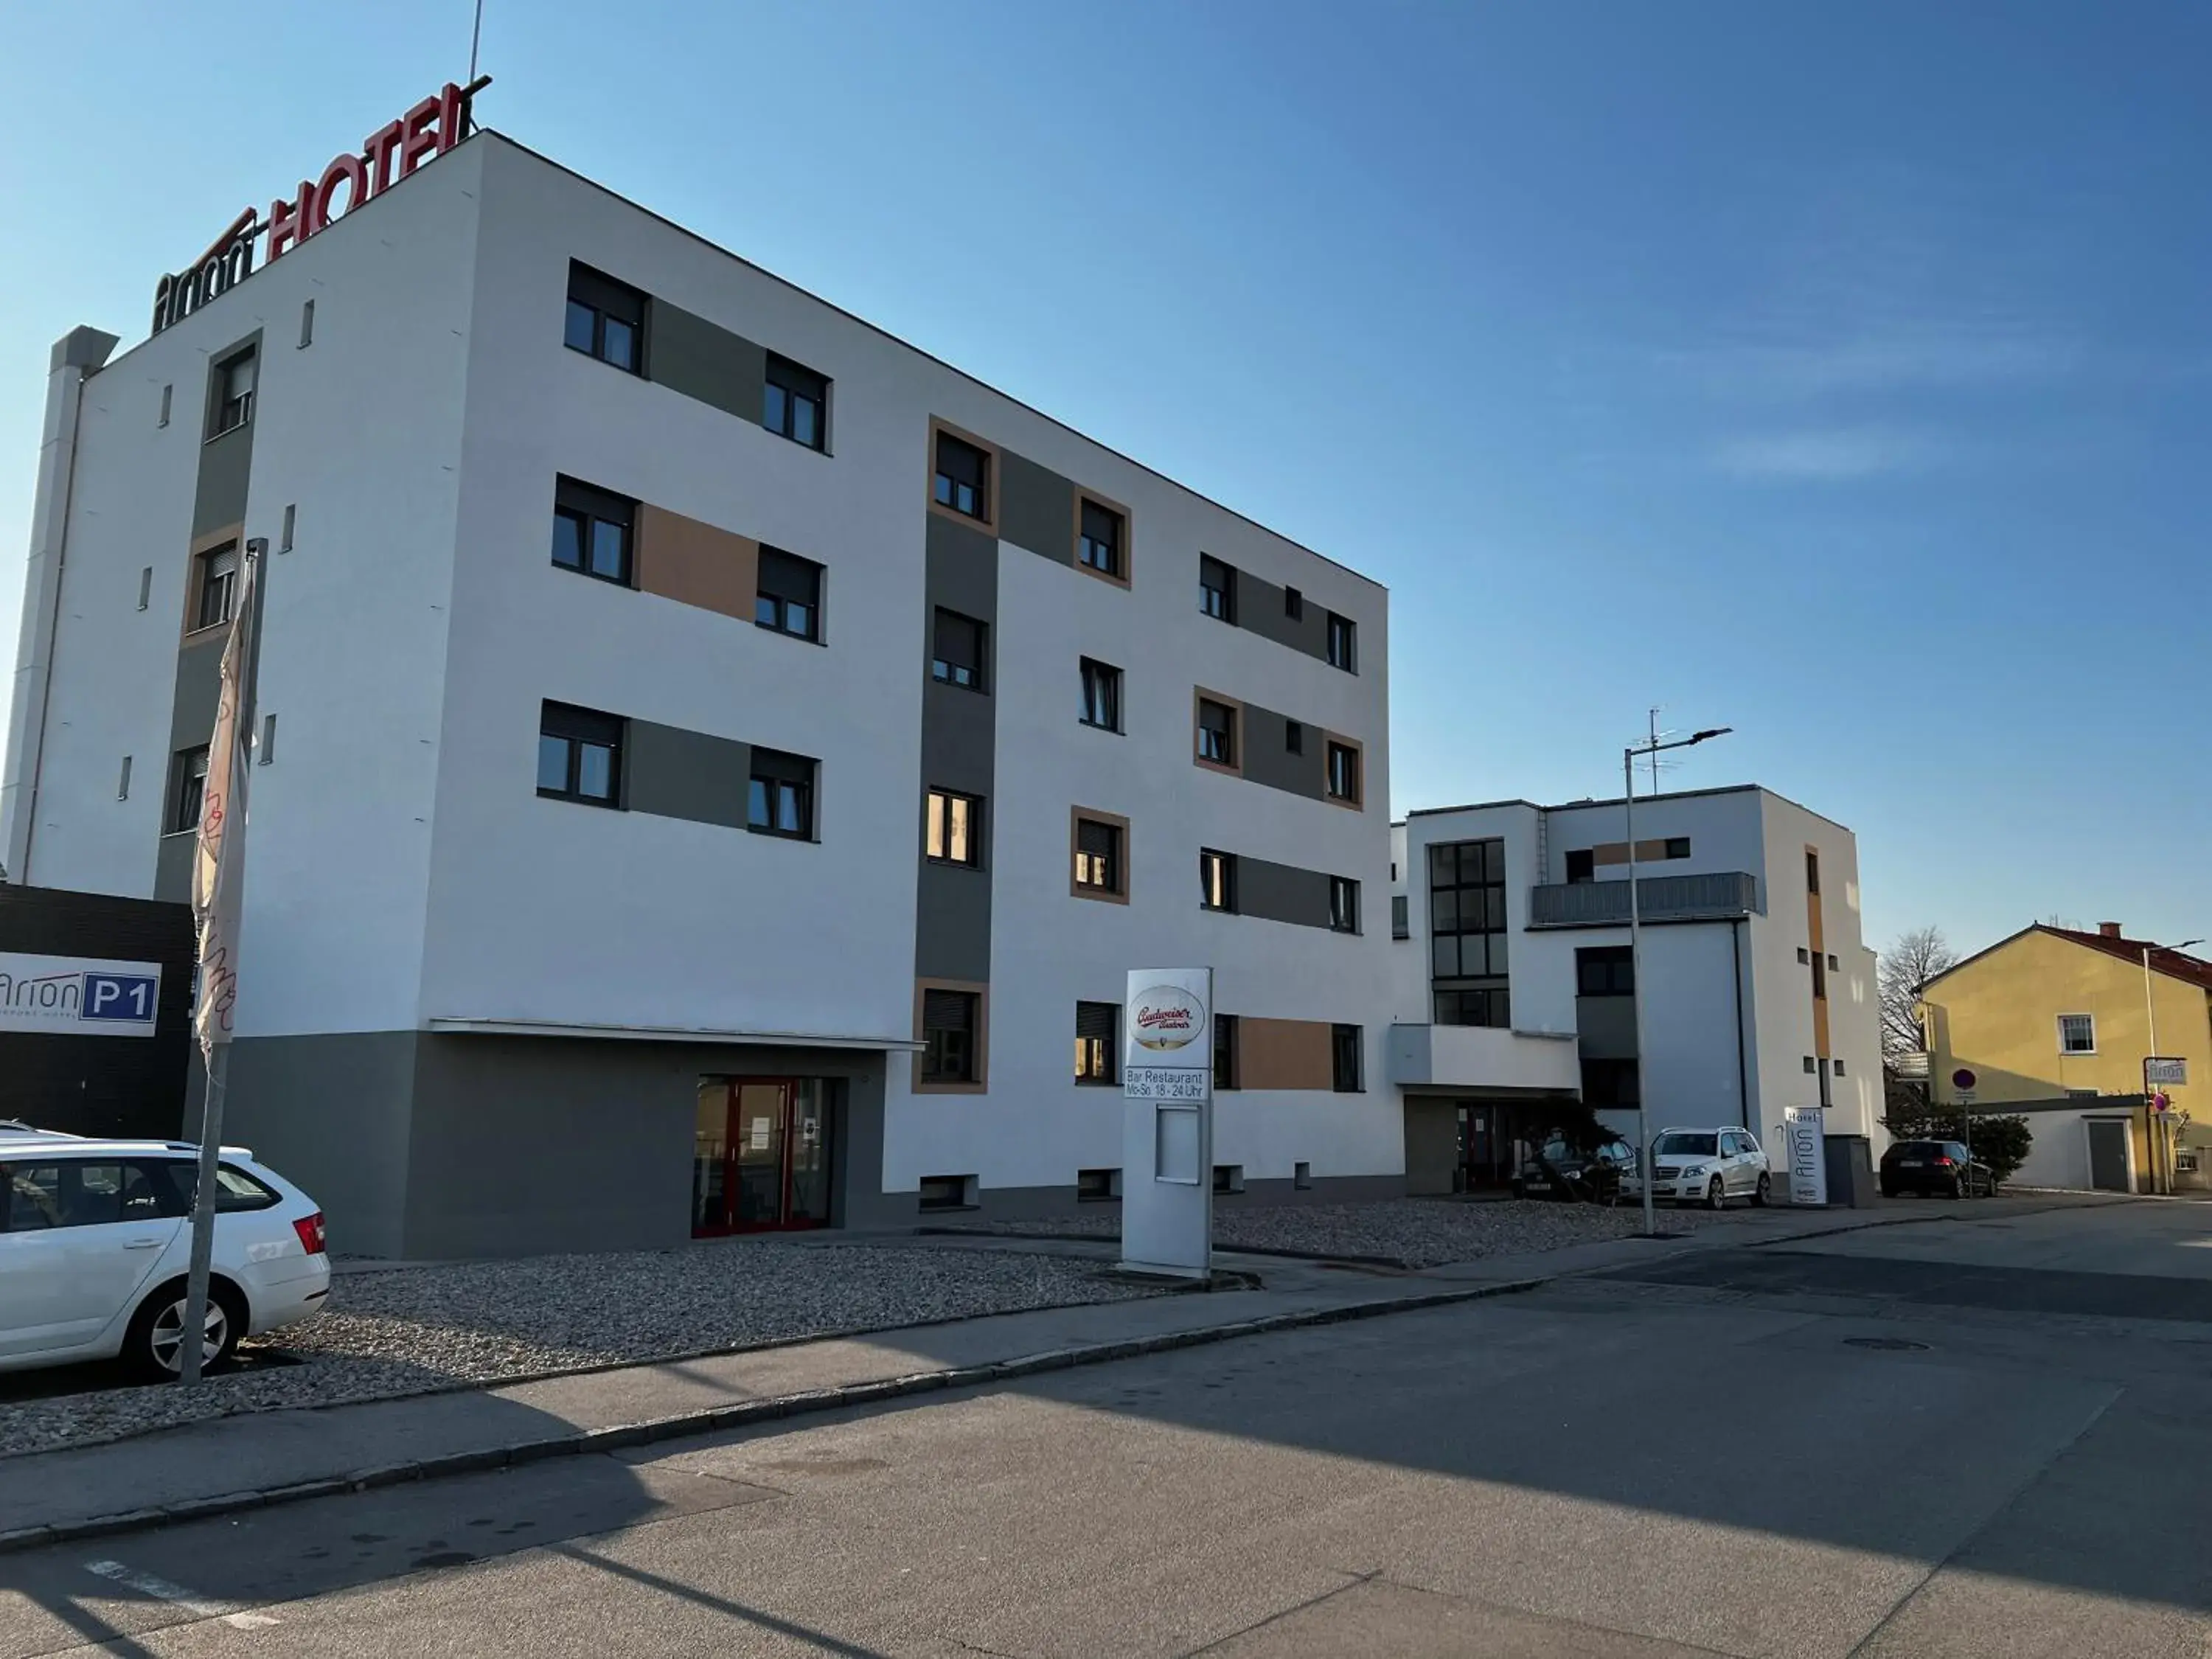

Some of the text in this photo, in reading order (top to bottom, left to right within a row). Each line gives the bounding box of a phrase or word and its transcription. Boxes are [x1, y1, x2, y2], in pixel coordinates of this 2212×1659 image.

[1127, 1070, 1203, 1084] Bar Restaurant
[1185, 1085, 1203, 1097] Uhr
